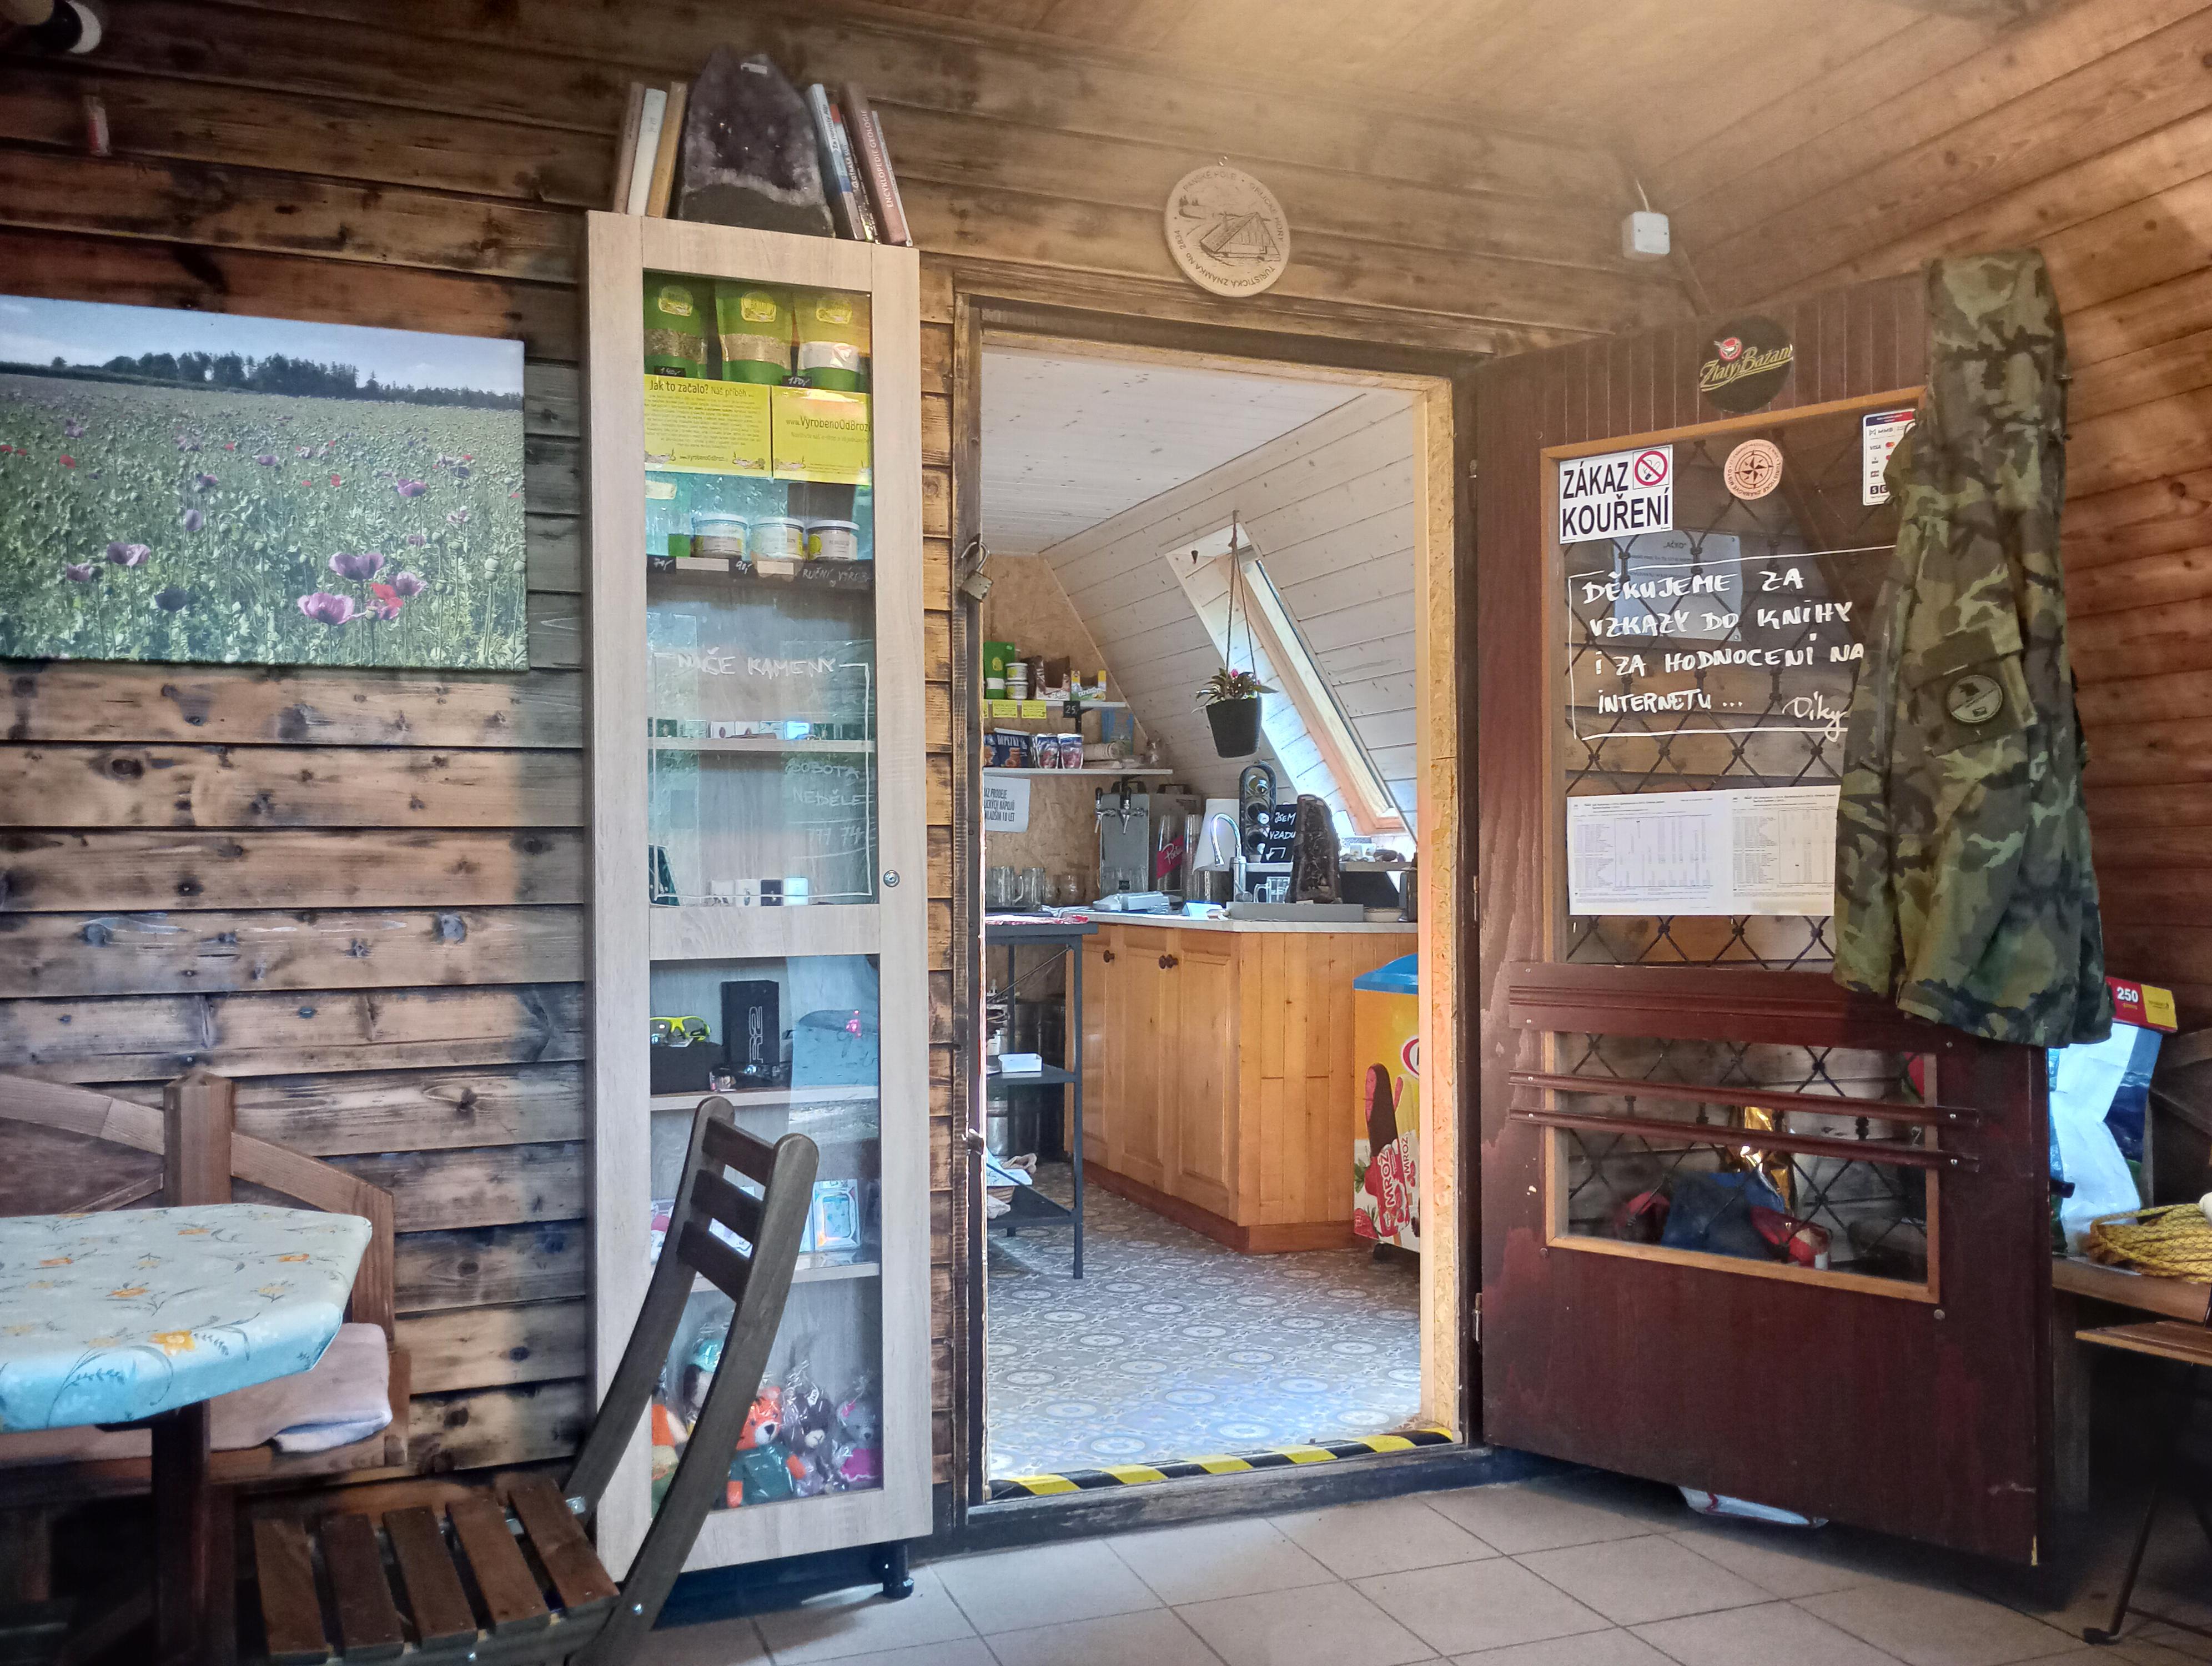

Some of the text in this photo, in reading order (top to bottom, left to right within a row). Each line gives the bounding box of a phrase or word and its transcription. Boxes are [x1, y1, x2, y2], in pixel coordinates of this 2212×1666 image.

[861, 110, 876, 148] GEOLOGIE
[873, 151, 893, 208] ENCYKLOPEDIE
[1195, 264, 1231, 287] ZNÁMKA
[1231, 266, 1275, 288] TURISTICKÁ
[1700, 359, 1740, 388] Zlatý
[650, 380, 663, 391] Jak
[667, 381, 676, 392] to
[678, 383, 708, 394] začalo?
[711, 386, 723, 395] Náš
[726, 388, 747, 398] příběh
[1563, 461, 1628, 499] ZÁKAZ
[1562, 487, 1670, 536] KOUŘENÍ
[1582, 568, 1804, 604] DĚKUJEME ZA
[1590, 610, 1690, 638] VZKAZY
[1701, 612, 1739, 631] DO
[748, 657, 836, 680] KAMENY
[1612, 654, 1646, 677] ZA
[1830, 643, 1864, 663] NA
[1274, 811, 1297, 826] JSEM
[2117, 986, 2139, 1002] 250
